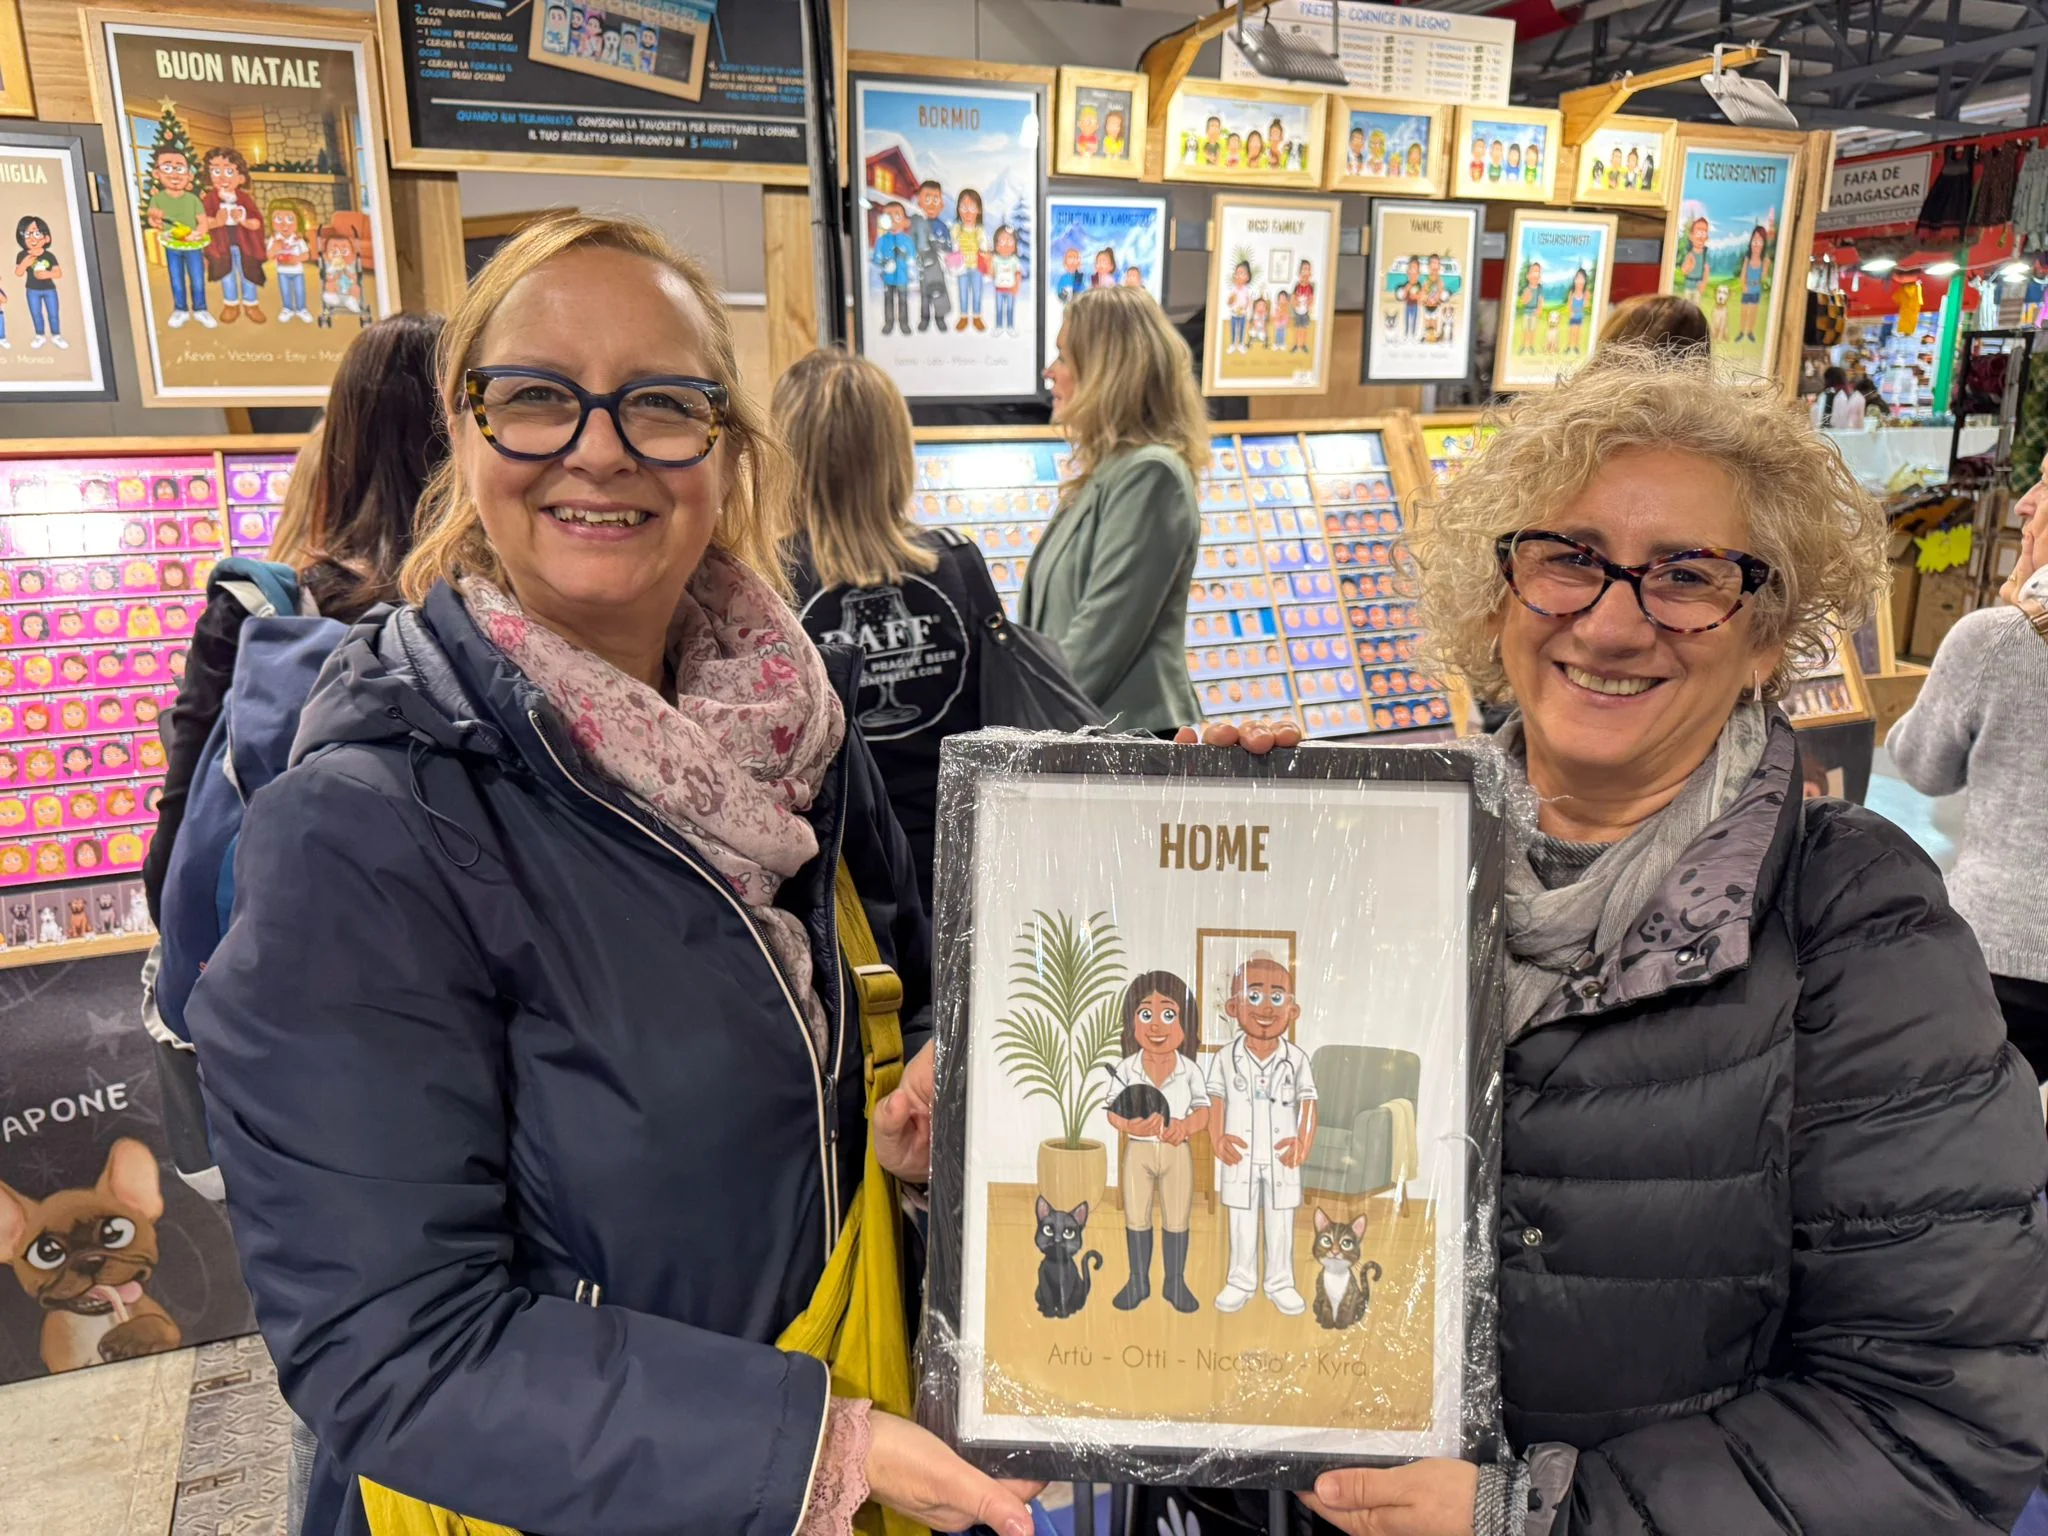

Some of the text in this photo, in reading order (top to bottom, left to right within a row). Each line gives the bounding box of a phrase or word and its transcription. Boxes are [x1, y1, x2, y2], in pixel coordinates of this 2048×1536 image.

[1349, 7, 1397, 25] CORNICE
[1400, 13, 1412, 26] IN
[1415, 14, 1451, 31] LEGNO
[155, 50, 322, 88] BUON NATALE
[639, 119, 688, 132] TAVOLETTA
[918, 104, 980, 131] BORMIO
[539, 129, 560, 142] TUO
[561, 131, 608, 143] RITRATTO
[634, 134, 672, 147] PRONTO
[0, 163, 48, 184] IGLIA
[1703, 161, 1776, 184] ESCURSIONISTI
[1844, 166, 1901, 186] FAFA DE
[227, 349, 273, 362] Victoria
[871, 650, 956, 672] PRAGUE BEER
[1160, 823, 1269, 871] HOME
[2, 1083, 128, 1142] APONE
[1047, 1342, 1092, 1366] Artù
[1122, 1344, 1166, 1368] Otti
[1317, 1352, 1367, 1380] Kyra
